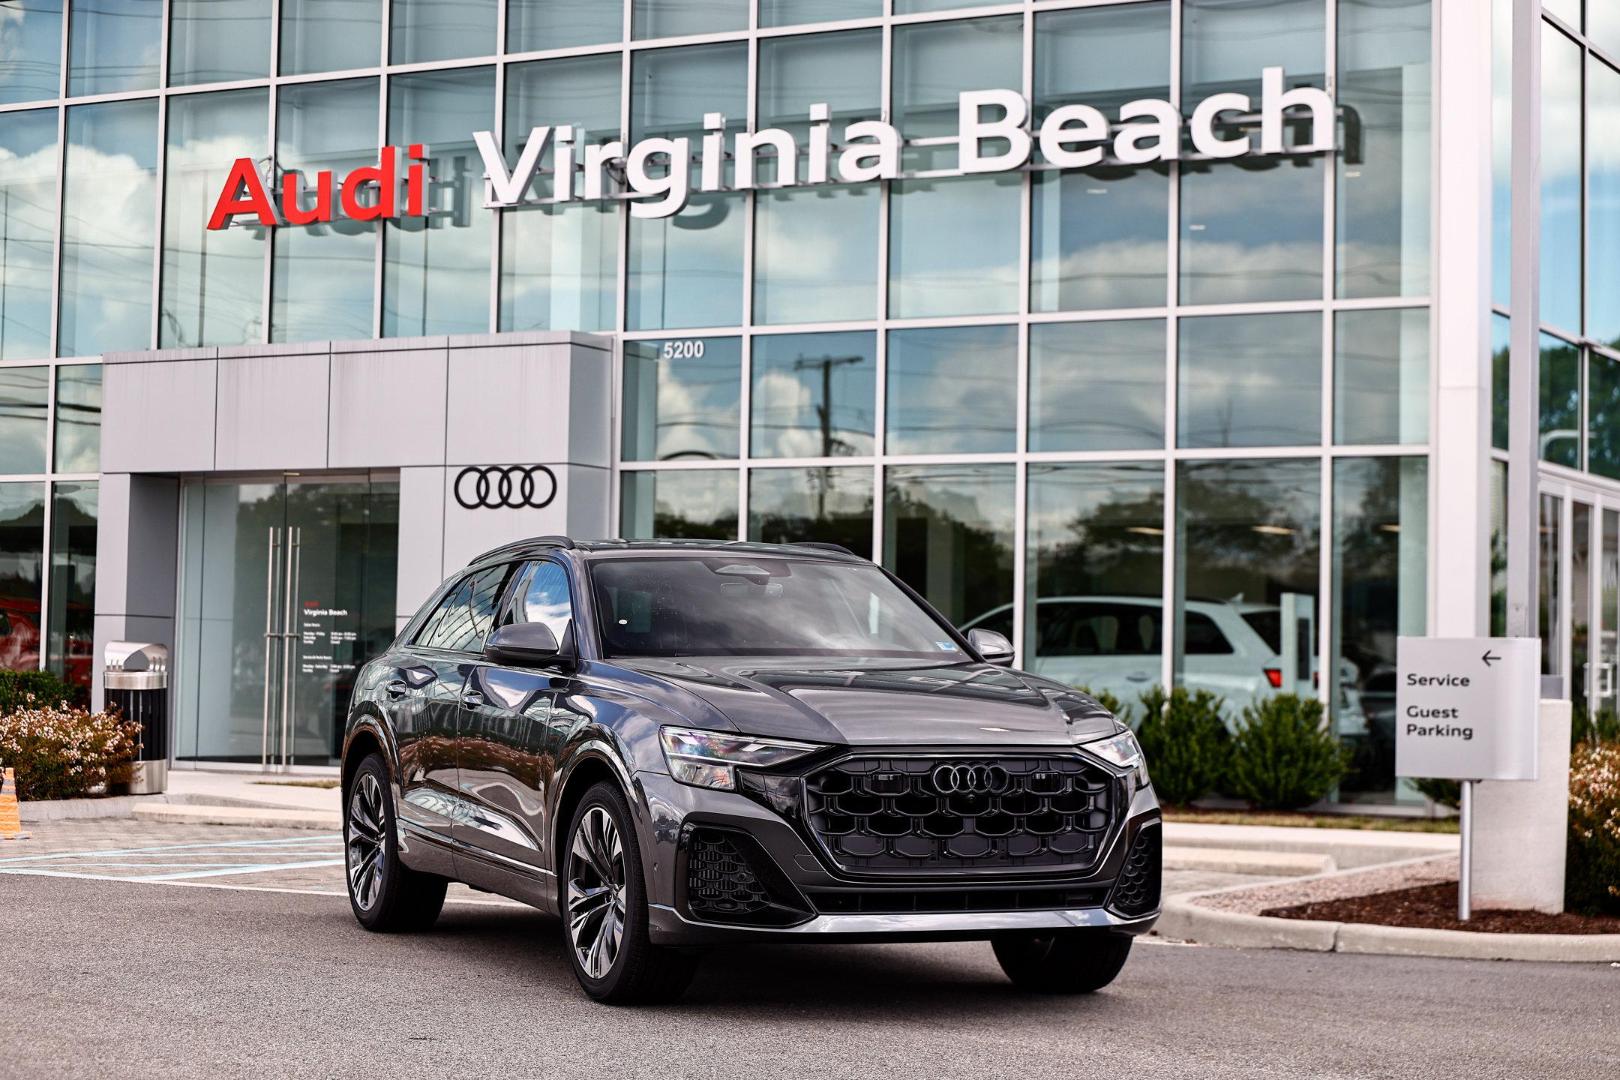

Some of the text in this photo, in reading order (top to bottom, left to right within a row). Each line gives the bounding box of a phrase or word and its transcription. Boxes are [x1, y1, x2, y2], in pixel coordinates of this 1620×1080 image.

[206, 67, 1336, 231] Audi Virginia Beach
[663, 340, 704, 359] 5200
[303, 609, 328, 617] Virginia
[1407, 673, 1471, 687] Service
[1407, 705, 1459, 719] Guest
[1407, 723, 1473, 741] Parking
